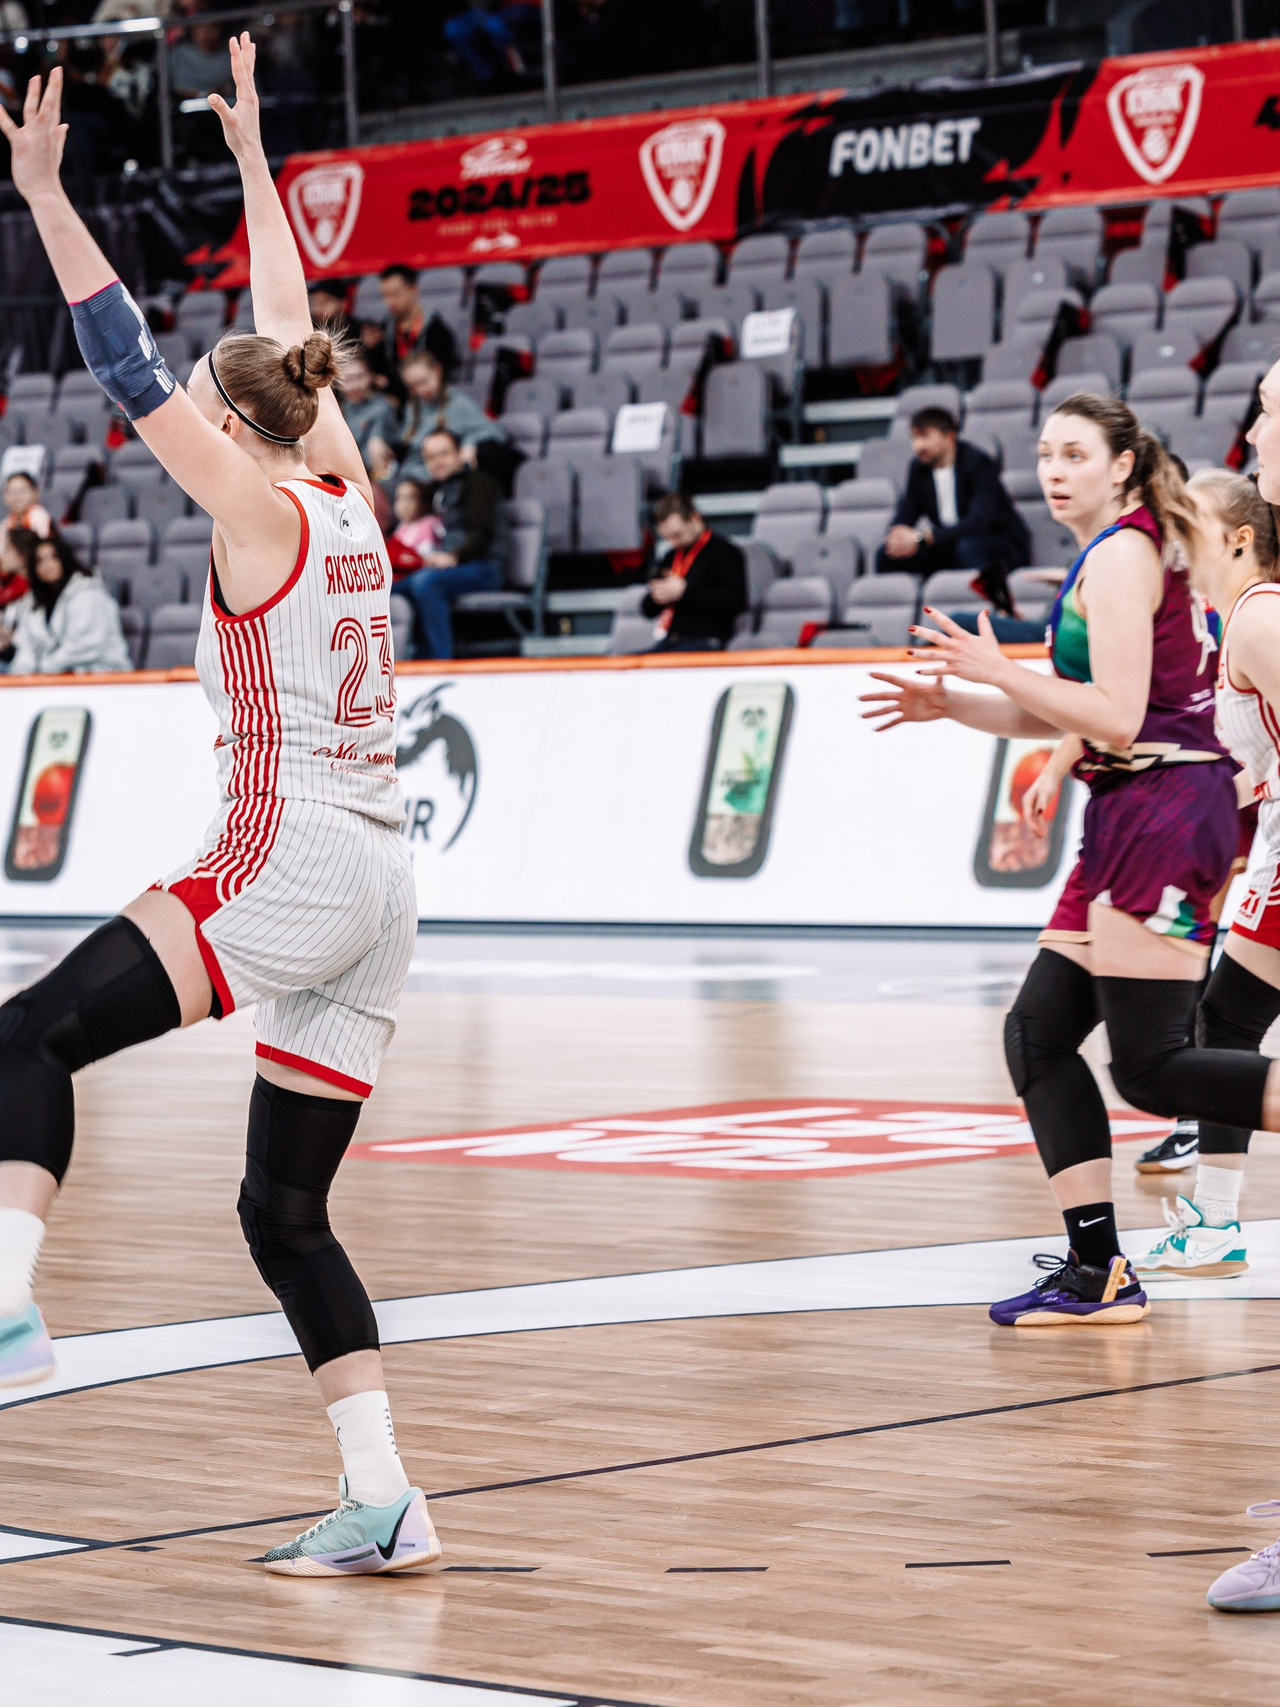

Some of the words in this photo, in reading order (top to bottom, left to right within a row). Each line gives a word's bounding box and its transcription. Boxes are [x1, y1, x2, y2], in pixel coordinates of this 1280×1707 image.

[828, 116, 982, 178] FONBET
[407, 170, 591, 221] 2024/25
[325, 551, 385, 595] ЯКОВЛЕВА
[330, 615, 397, 728] 23
